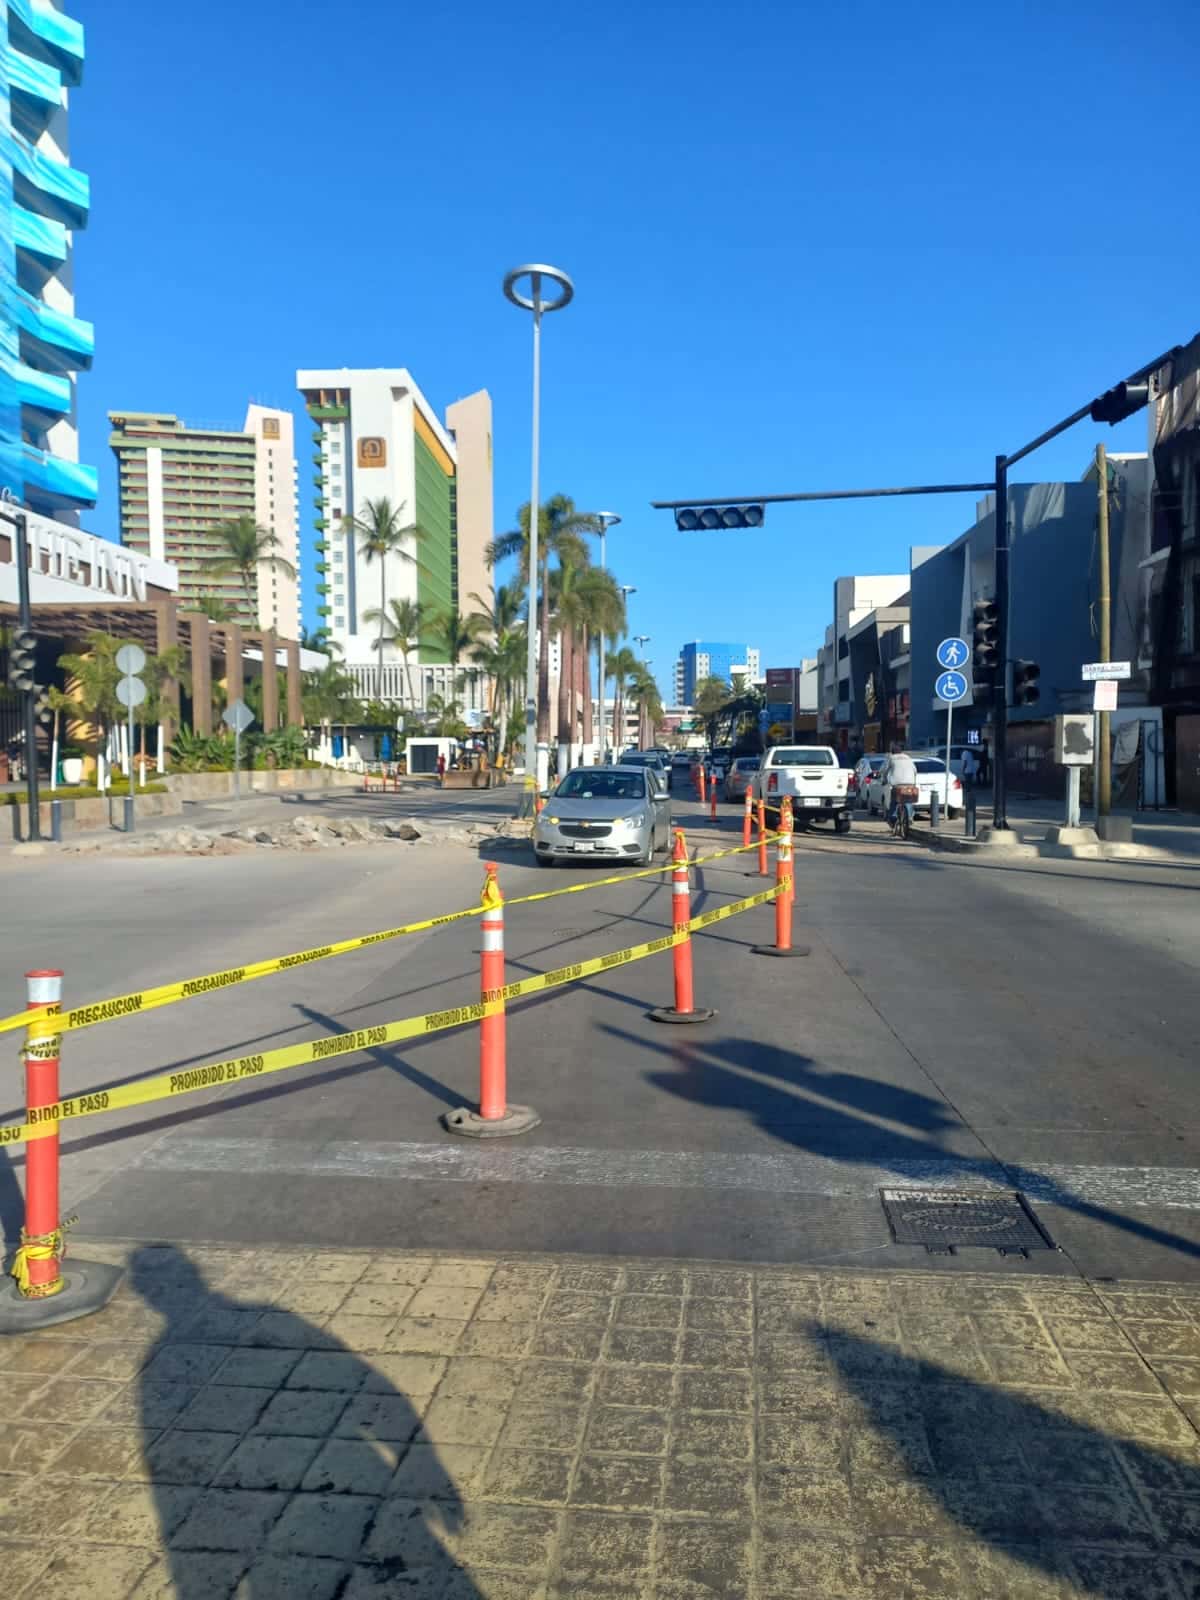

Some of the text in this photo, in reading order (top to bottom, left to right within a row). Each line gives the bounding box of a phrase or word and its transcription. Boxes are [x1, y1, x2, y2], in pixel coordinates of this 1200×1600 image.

[69, 995, 143, 1028] PRECAUCION
[357, 1031, 366, 1047] EL
[367, 1026, 387, 1045] PASO
[170, 1055, 264, 1092] PROHIBIDO EL PASO
[63, 1101, 76, 1117] EL
[79, 1092, 109, 1113] PASO
